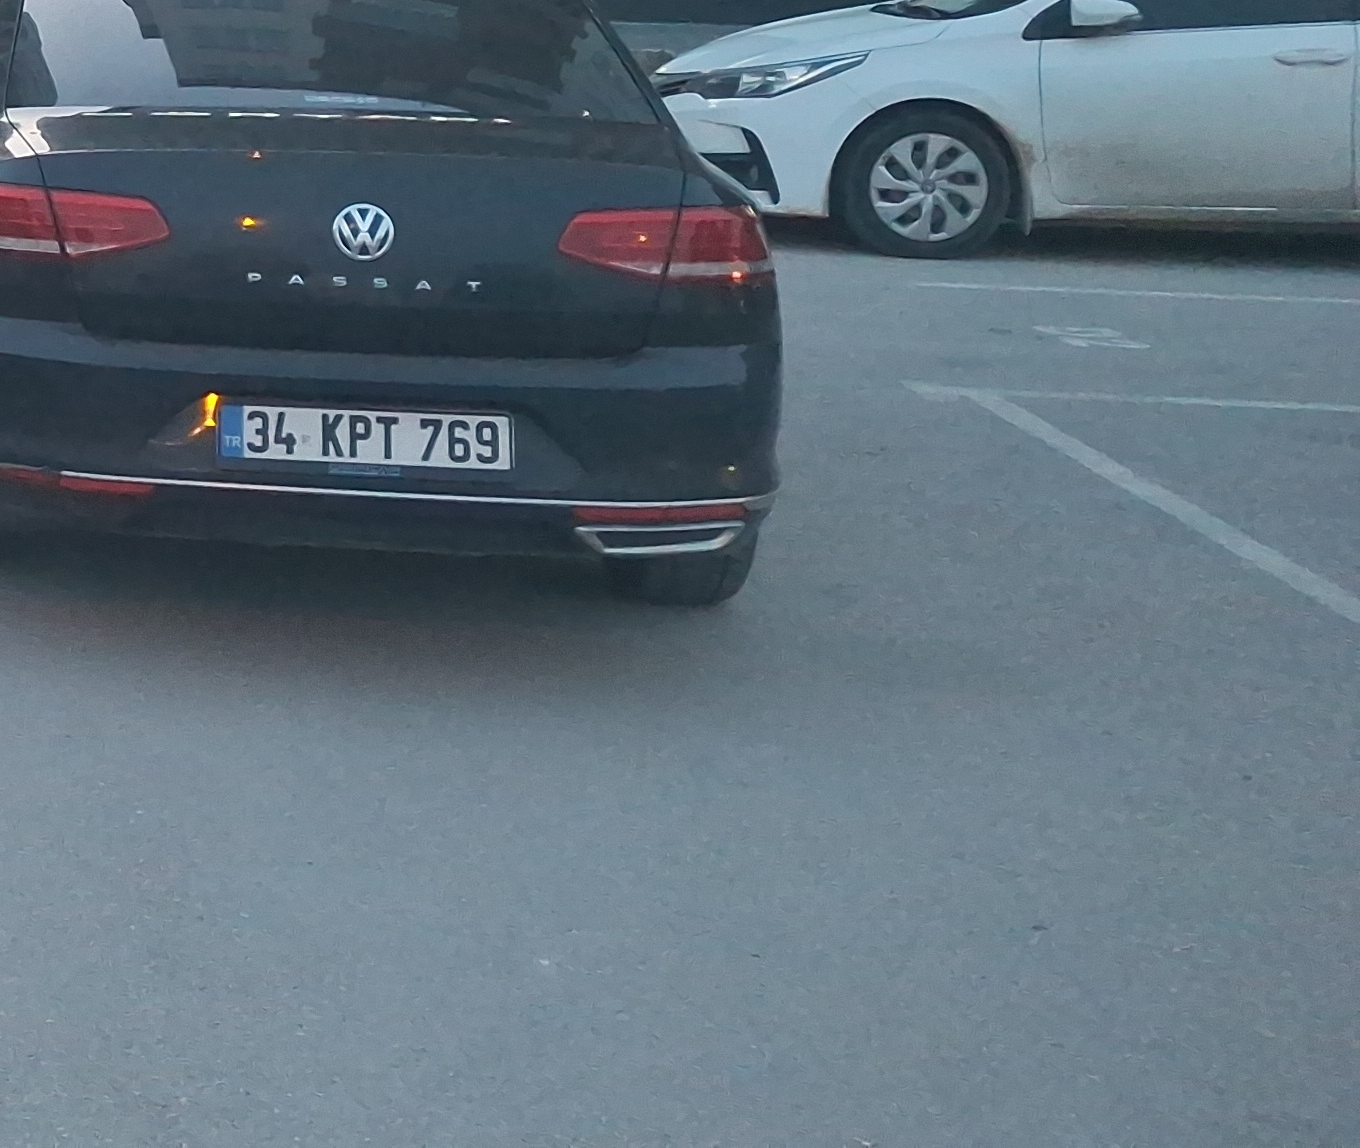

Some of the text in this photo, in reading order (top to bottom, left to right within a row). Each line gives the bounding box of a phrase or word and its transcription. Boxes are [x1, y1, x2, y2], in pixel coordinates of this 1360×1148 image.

[247, 272, 481, 292] PASSAT
[224, 410, 499, 464] TR 34 KPT 769
